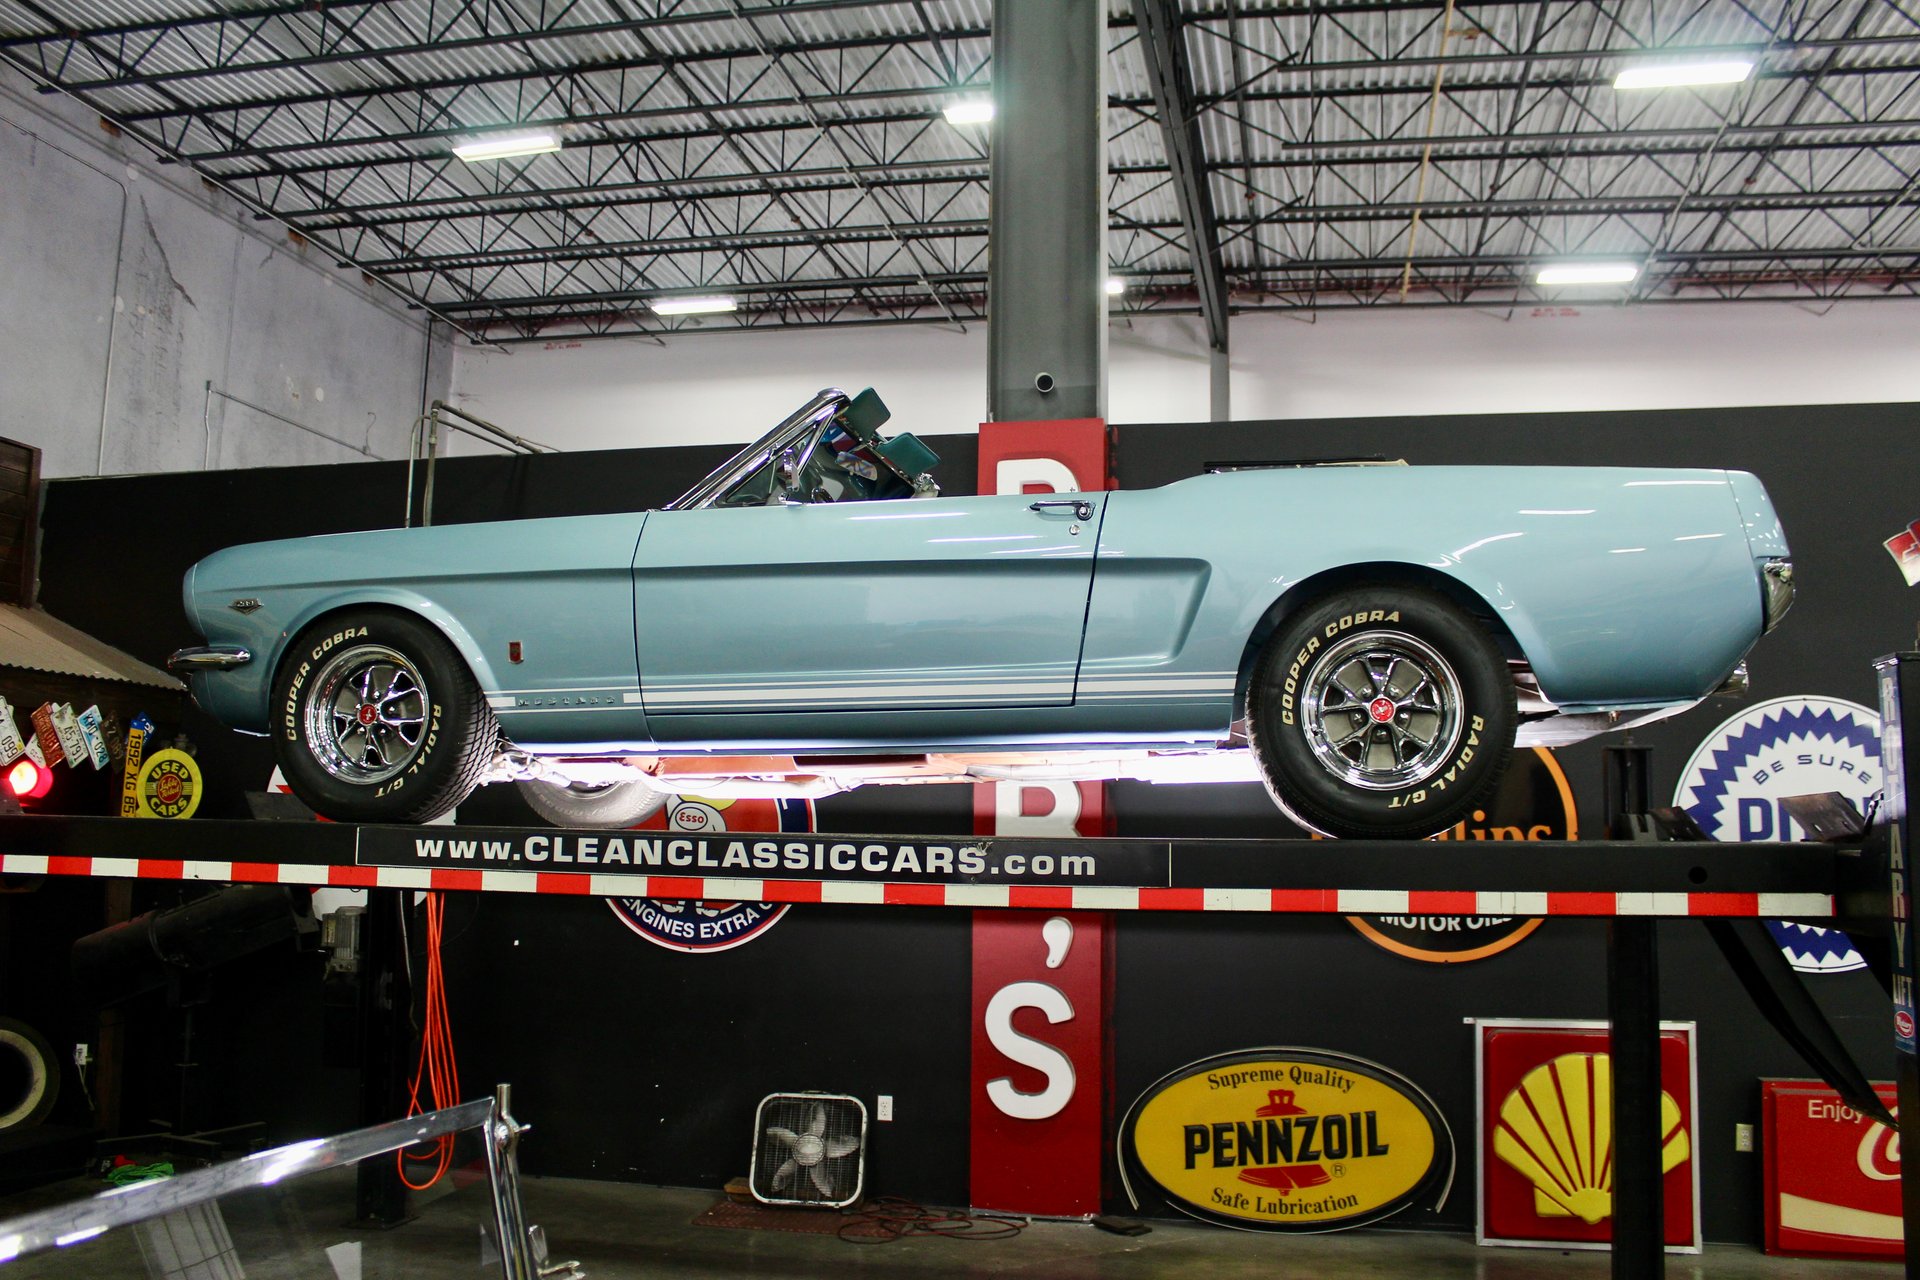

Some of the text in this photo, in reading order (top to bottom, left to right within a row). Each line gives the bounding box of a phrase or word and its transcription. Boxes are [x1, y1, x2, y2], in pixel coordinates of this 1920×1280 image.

[286, 626, 369, 741] COOPER COBRA
[1282, 609, 1400, 726] COOPER COBRA
[374, 704, 442, 798] RADIAL G/T
[1387, 715, 1485, 809] RADIAL G/T
[1752, 754, 1872, 785] BE SURE
[123, 734, 142, 814] 1992 XG 85
[151, 761, 189, 779] USED
[150, 797, 188, 816] CARS
[415, 835, 1097, 876] www.CLEANCLASSICCARS.com
[700, 906, 760, 939] EXTRA
[1208, 1065, 1356, 1094] Supreme Quality
[1808, 1100, 1865, 1124] Enjoy
[1183, 1111, 1390, 1170] PENNZOIL
[1211, 1187, 1359, 1216] Safe Lubrication
